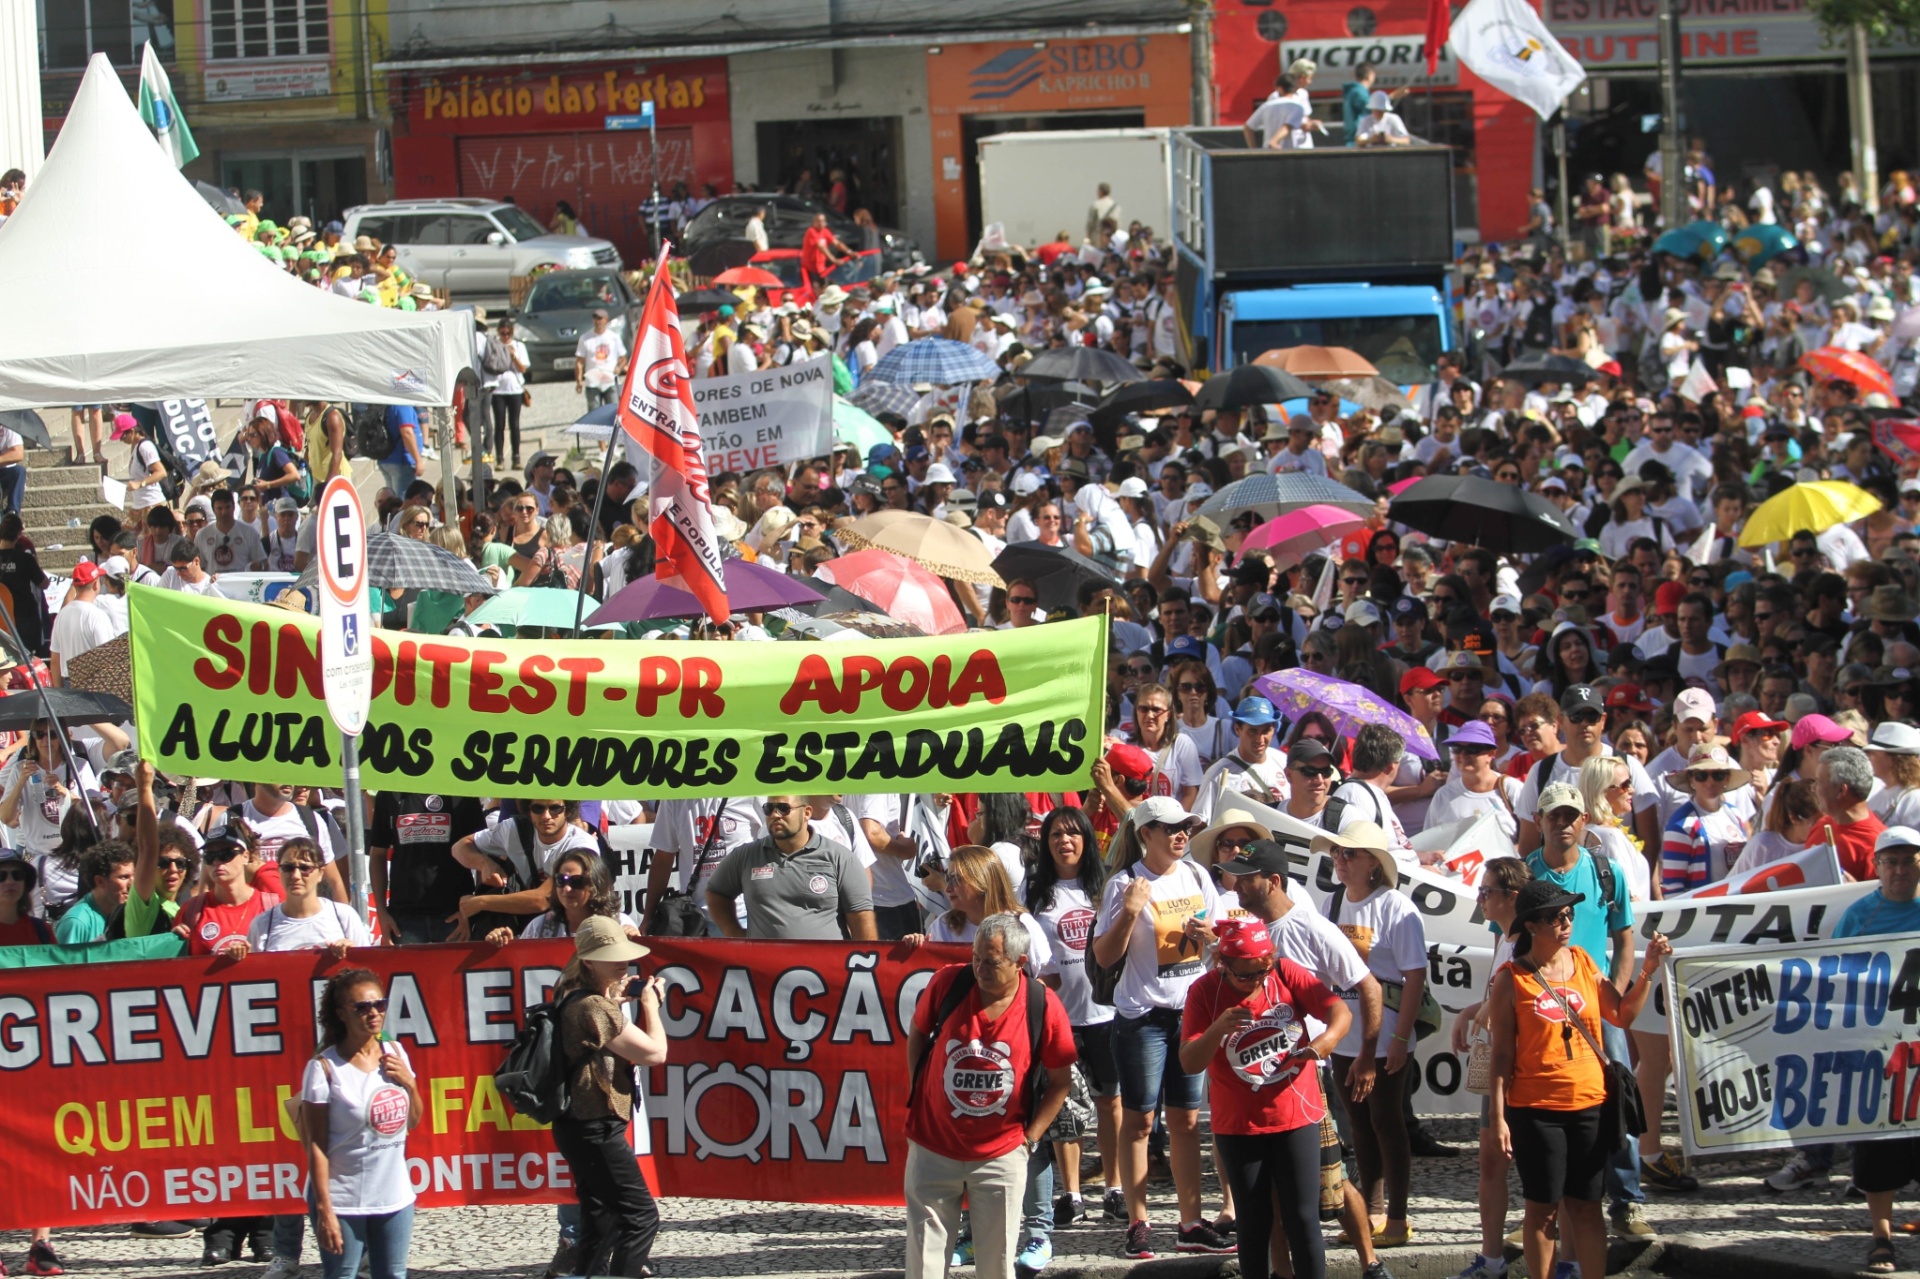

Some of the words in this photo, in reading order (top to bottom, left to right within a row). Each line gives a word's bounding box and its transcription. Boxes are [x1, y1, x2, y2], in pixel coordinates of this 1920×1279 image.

[1049, 42, 1145, 74] SEBO
[424, 76, 532, 119] Palácio
[543, 75, 597, 114] das
[604, 70, 706, 112] Festas
[1038, 74, 1136, 93] KAPRICHO
[693, 385, 741, 403] ORES
[750, 378, 774, 395] DE
[780, 366, 825, 390] NOVA
[700, 431, 742, 452] TÃO
[756, 425, 783, 443] EM
[708, 444, 779, 475] REVE
[333, 504, 354, 578] E
[779, 648, 1007, 715] APOIA
[159, 703, 200, 761] A
[208, 708, 331, 768] LUTA
[450, 730, 740, 788] SERVIDORES
[755, 718, 1087, 784] ESTADUAIS
[399, 815, 446, 826] CSP
[1166, 898, 1191, 909] LUTO
[1061, 921, 1072, 930] EU
[1073, 918, 1084, 928] TÔ
[1640, 904, 1828, 946] UTA!
[1539, 993, 1579, 1010] GRE
[1681, 963, 1775, 1038] ONTEM
[1772, 951, 1891, 1035] BETO
[0, 979, 284, 1073] GREVE
[309, 971, 440, 1047] A
[951, 1049, 968, 1061] QUEM
[1239, 1033, 1289, 1065] GREVE
[952, 1072, 1004, 1089] GREVE
[1694, 1063, 1772, 1130] HOJE
[1769, 1050, 1884, 1130] BETO
[373, 1105, 384, 1115] EU
[385, 1100, 395, 1111] TÔ
[374, 1106, 407, 1123] LUTA!
[54, 1095, 214, 1156] QUEM
[69, 1166, 150, 1210] NÃO
[164, 1163, 308, 1205] ESPER
[410, 1152, 573, 1195] ONTECE
